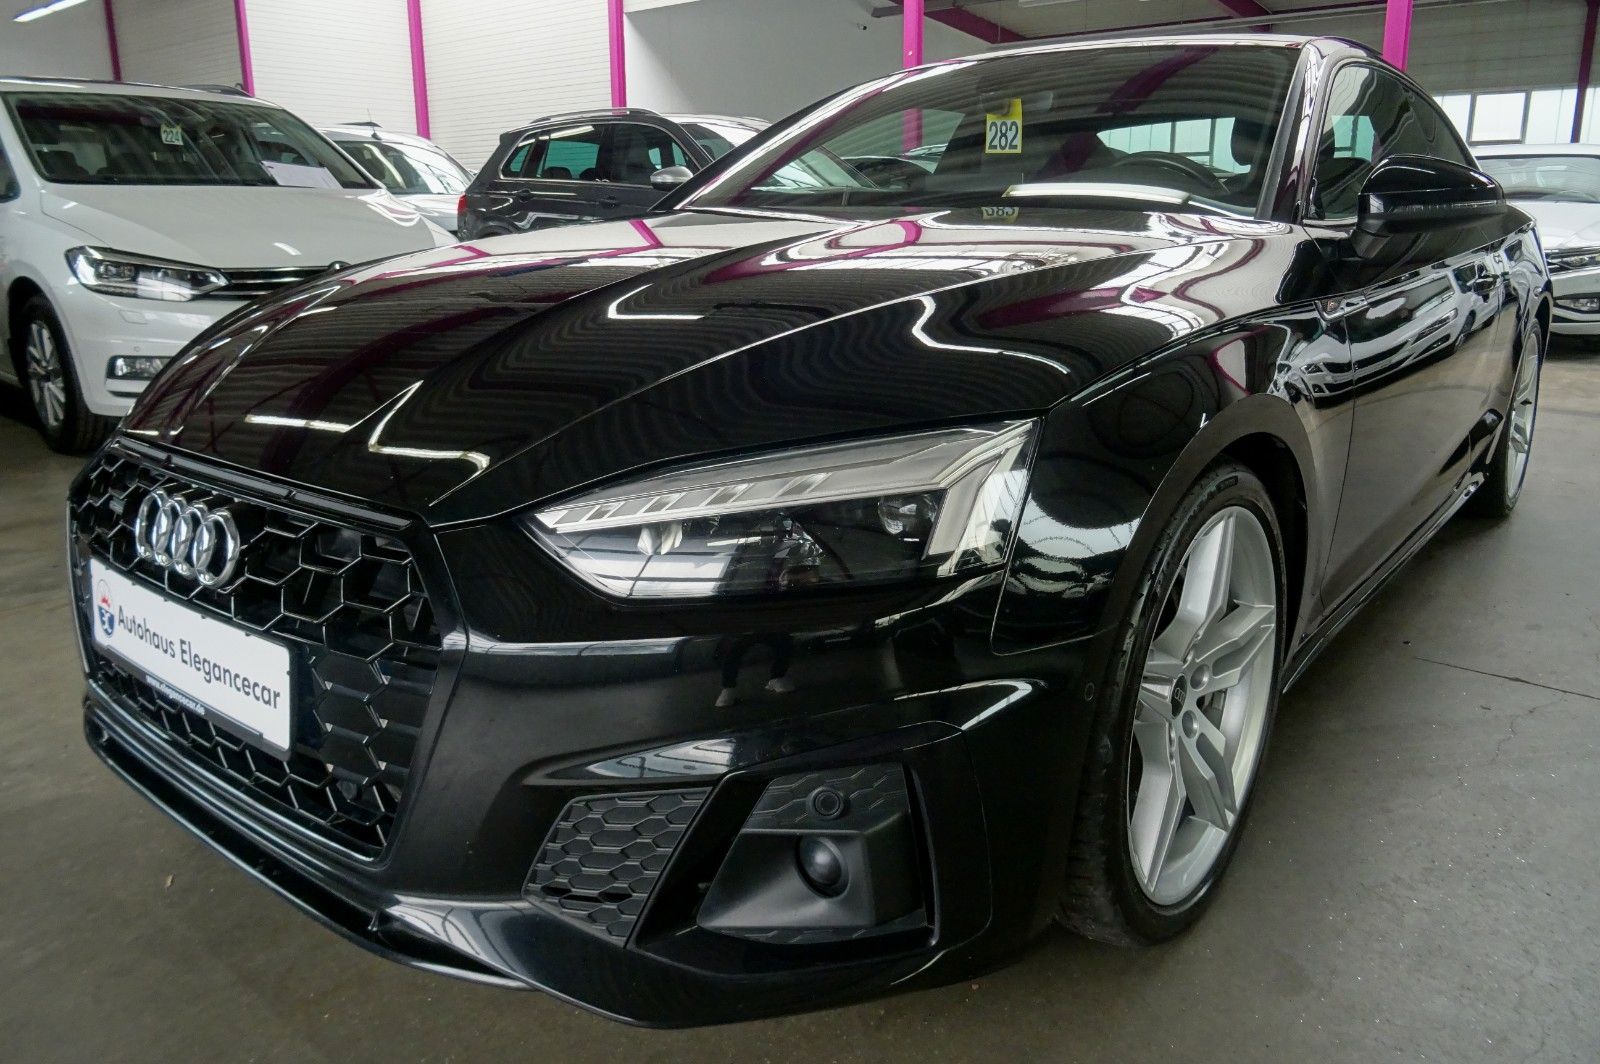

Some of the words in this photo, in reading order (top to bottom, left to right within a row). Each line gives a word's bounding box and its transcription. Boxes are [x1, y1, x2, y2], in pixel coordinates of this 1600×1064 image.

[988, 120, 1019, 151] 282
[118, 604, 176, 659] Autohaus
[179, 637, 281, 709] Elegancecar
